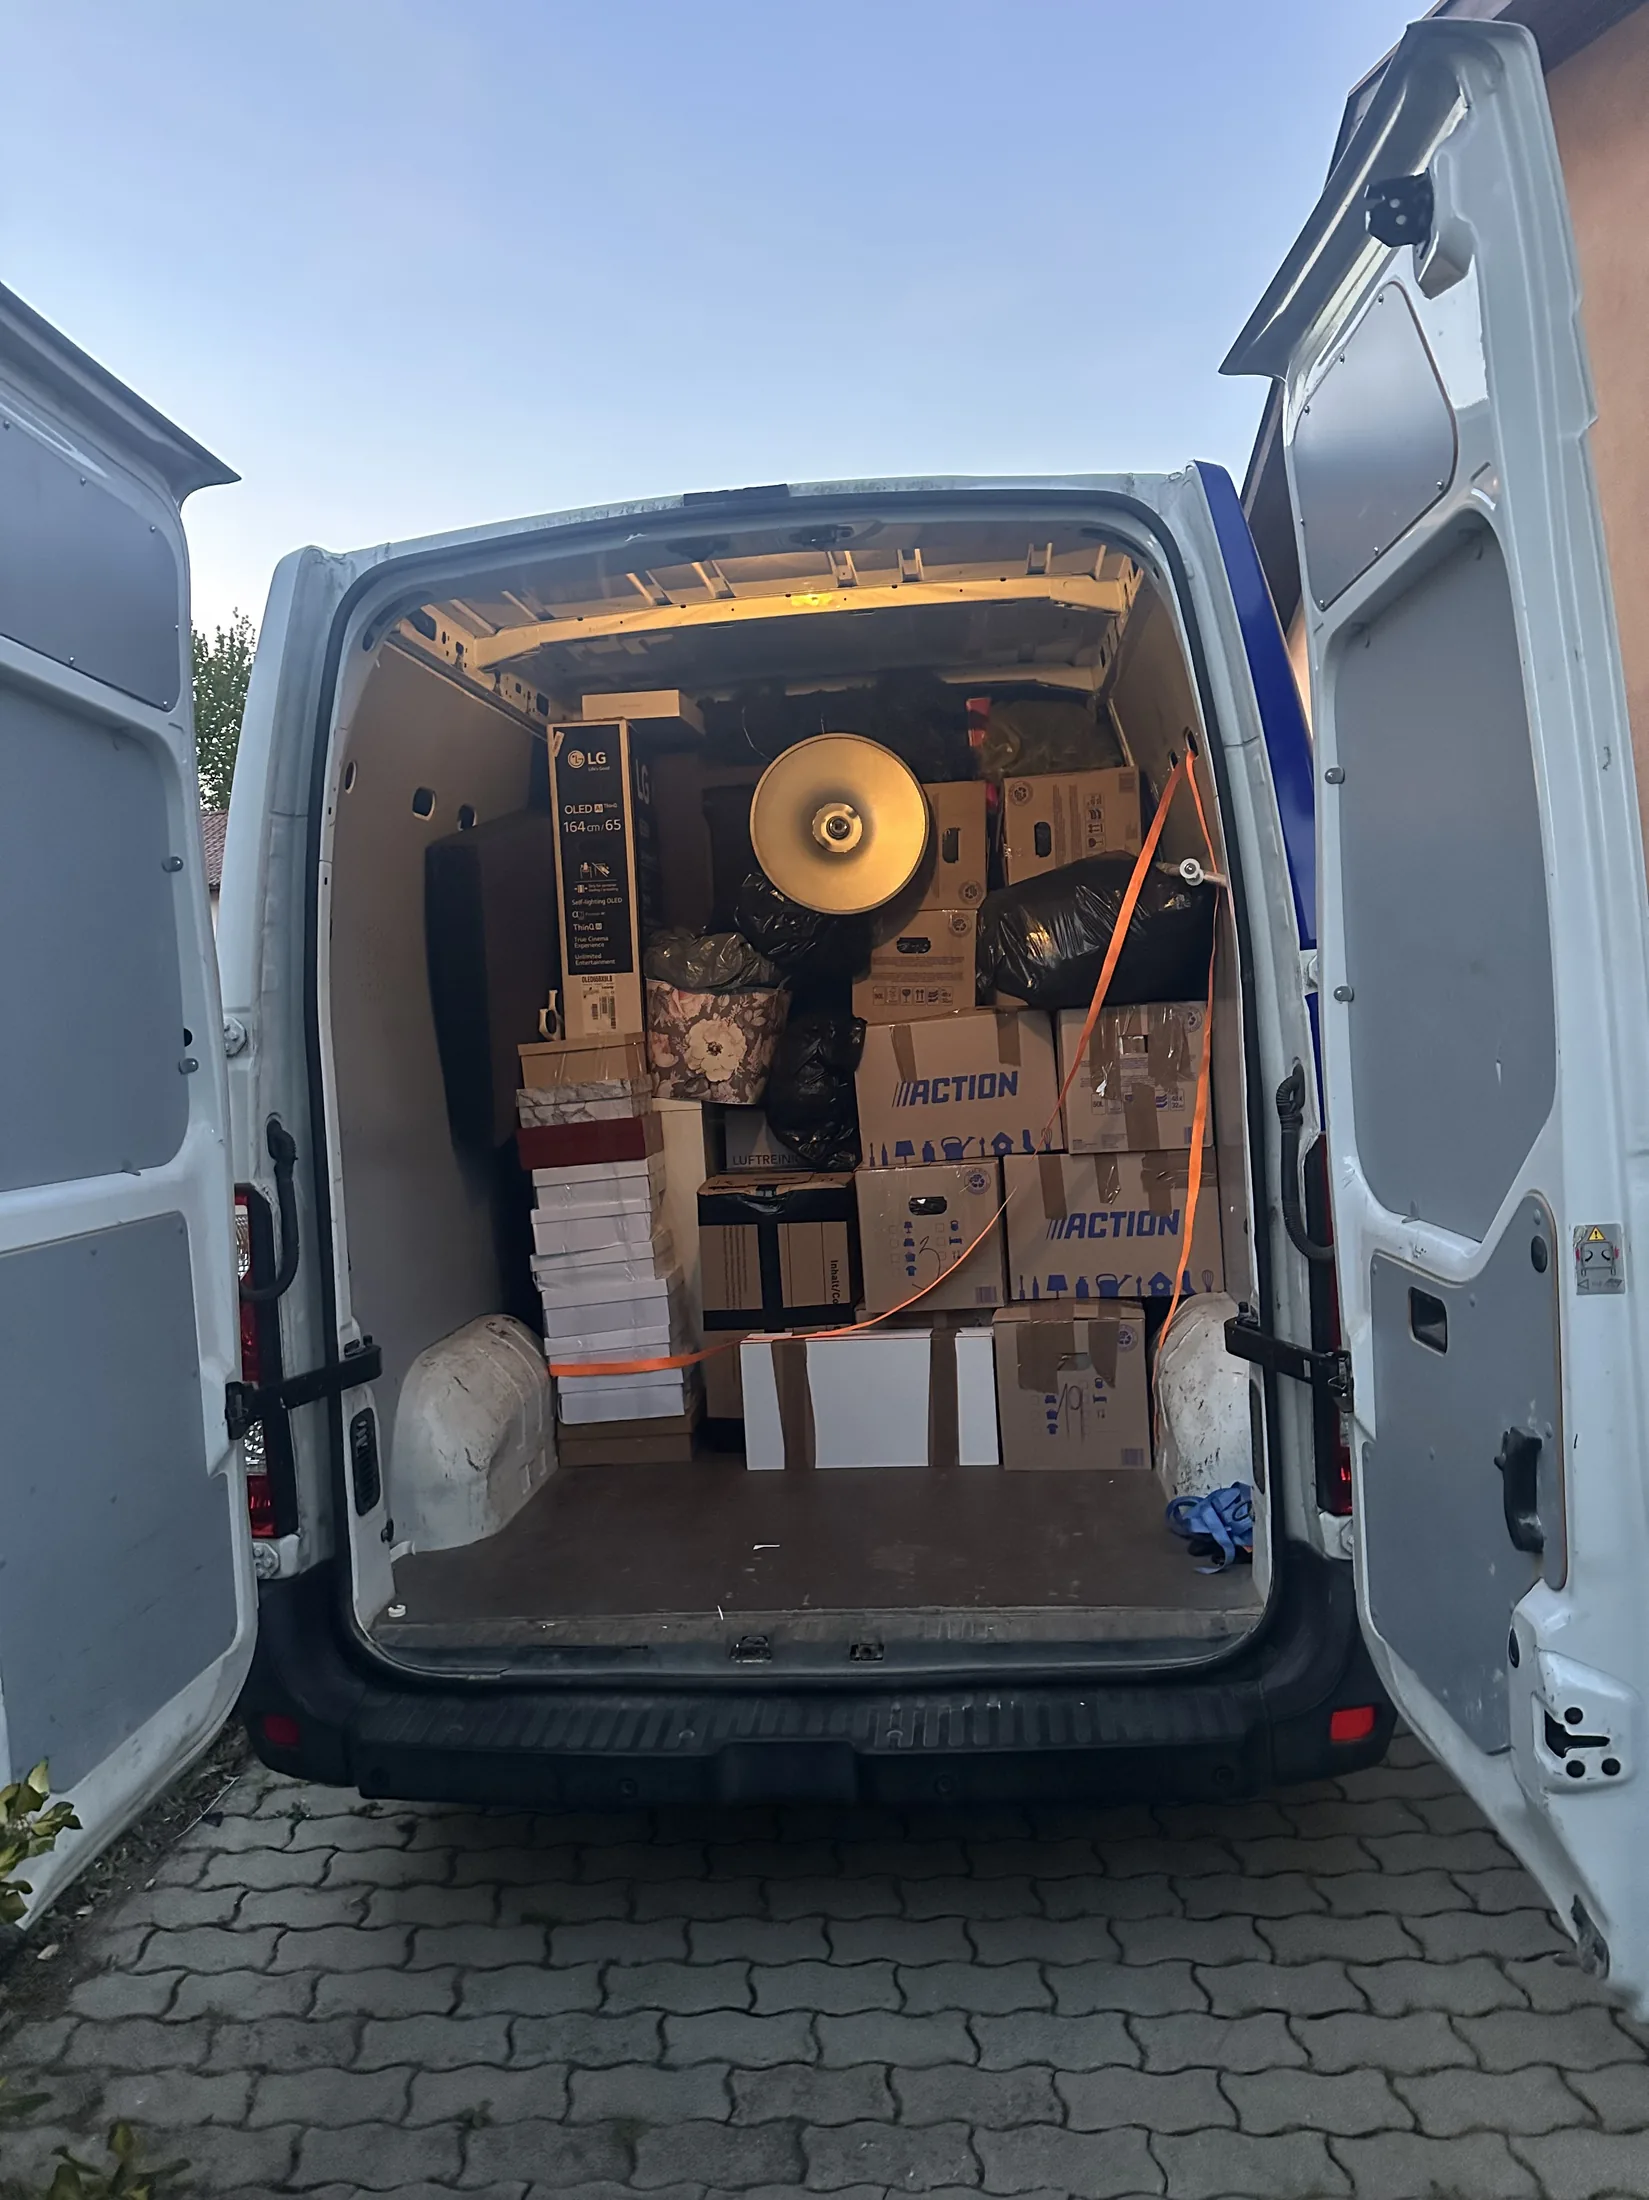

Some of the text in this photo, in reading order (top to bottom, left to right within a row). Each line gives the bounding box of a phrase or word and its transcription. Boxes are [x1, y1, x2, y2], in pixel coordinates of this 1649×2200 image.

[587, 751, 607, 765] LG
[564, 804, 593, 815] OLED
[563, 820, 586, 833] 164
[606, 897, 623, 905] OLED
[907, 1070, 1019, 1106] ACTION
[1063, 1209, 1181, 1240] ACTION
